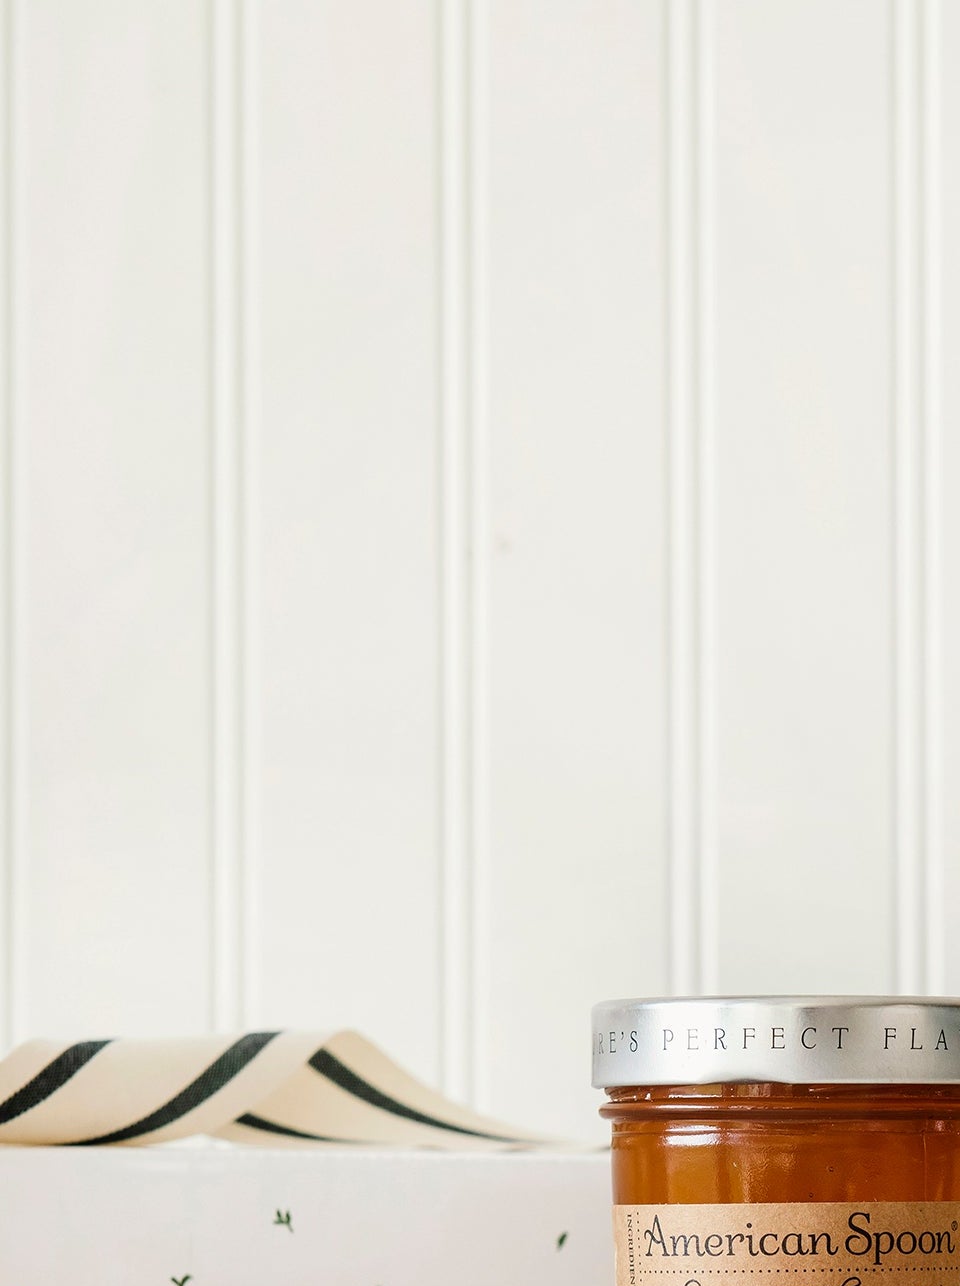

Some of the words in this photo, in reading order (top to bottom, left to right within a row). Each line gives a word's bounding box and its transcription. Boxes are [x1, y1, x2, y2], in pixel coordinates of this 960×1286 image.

[593, 1030, 638, 1054] RE'S
[663, 1027, 849, 1051] PERFECT
[644, 1215, 838, 1256] American
